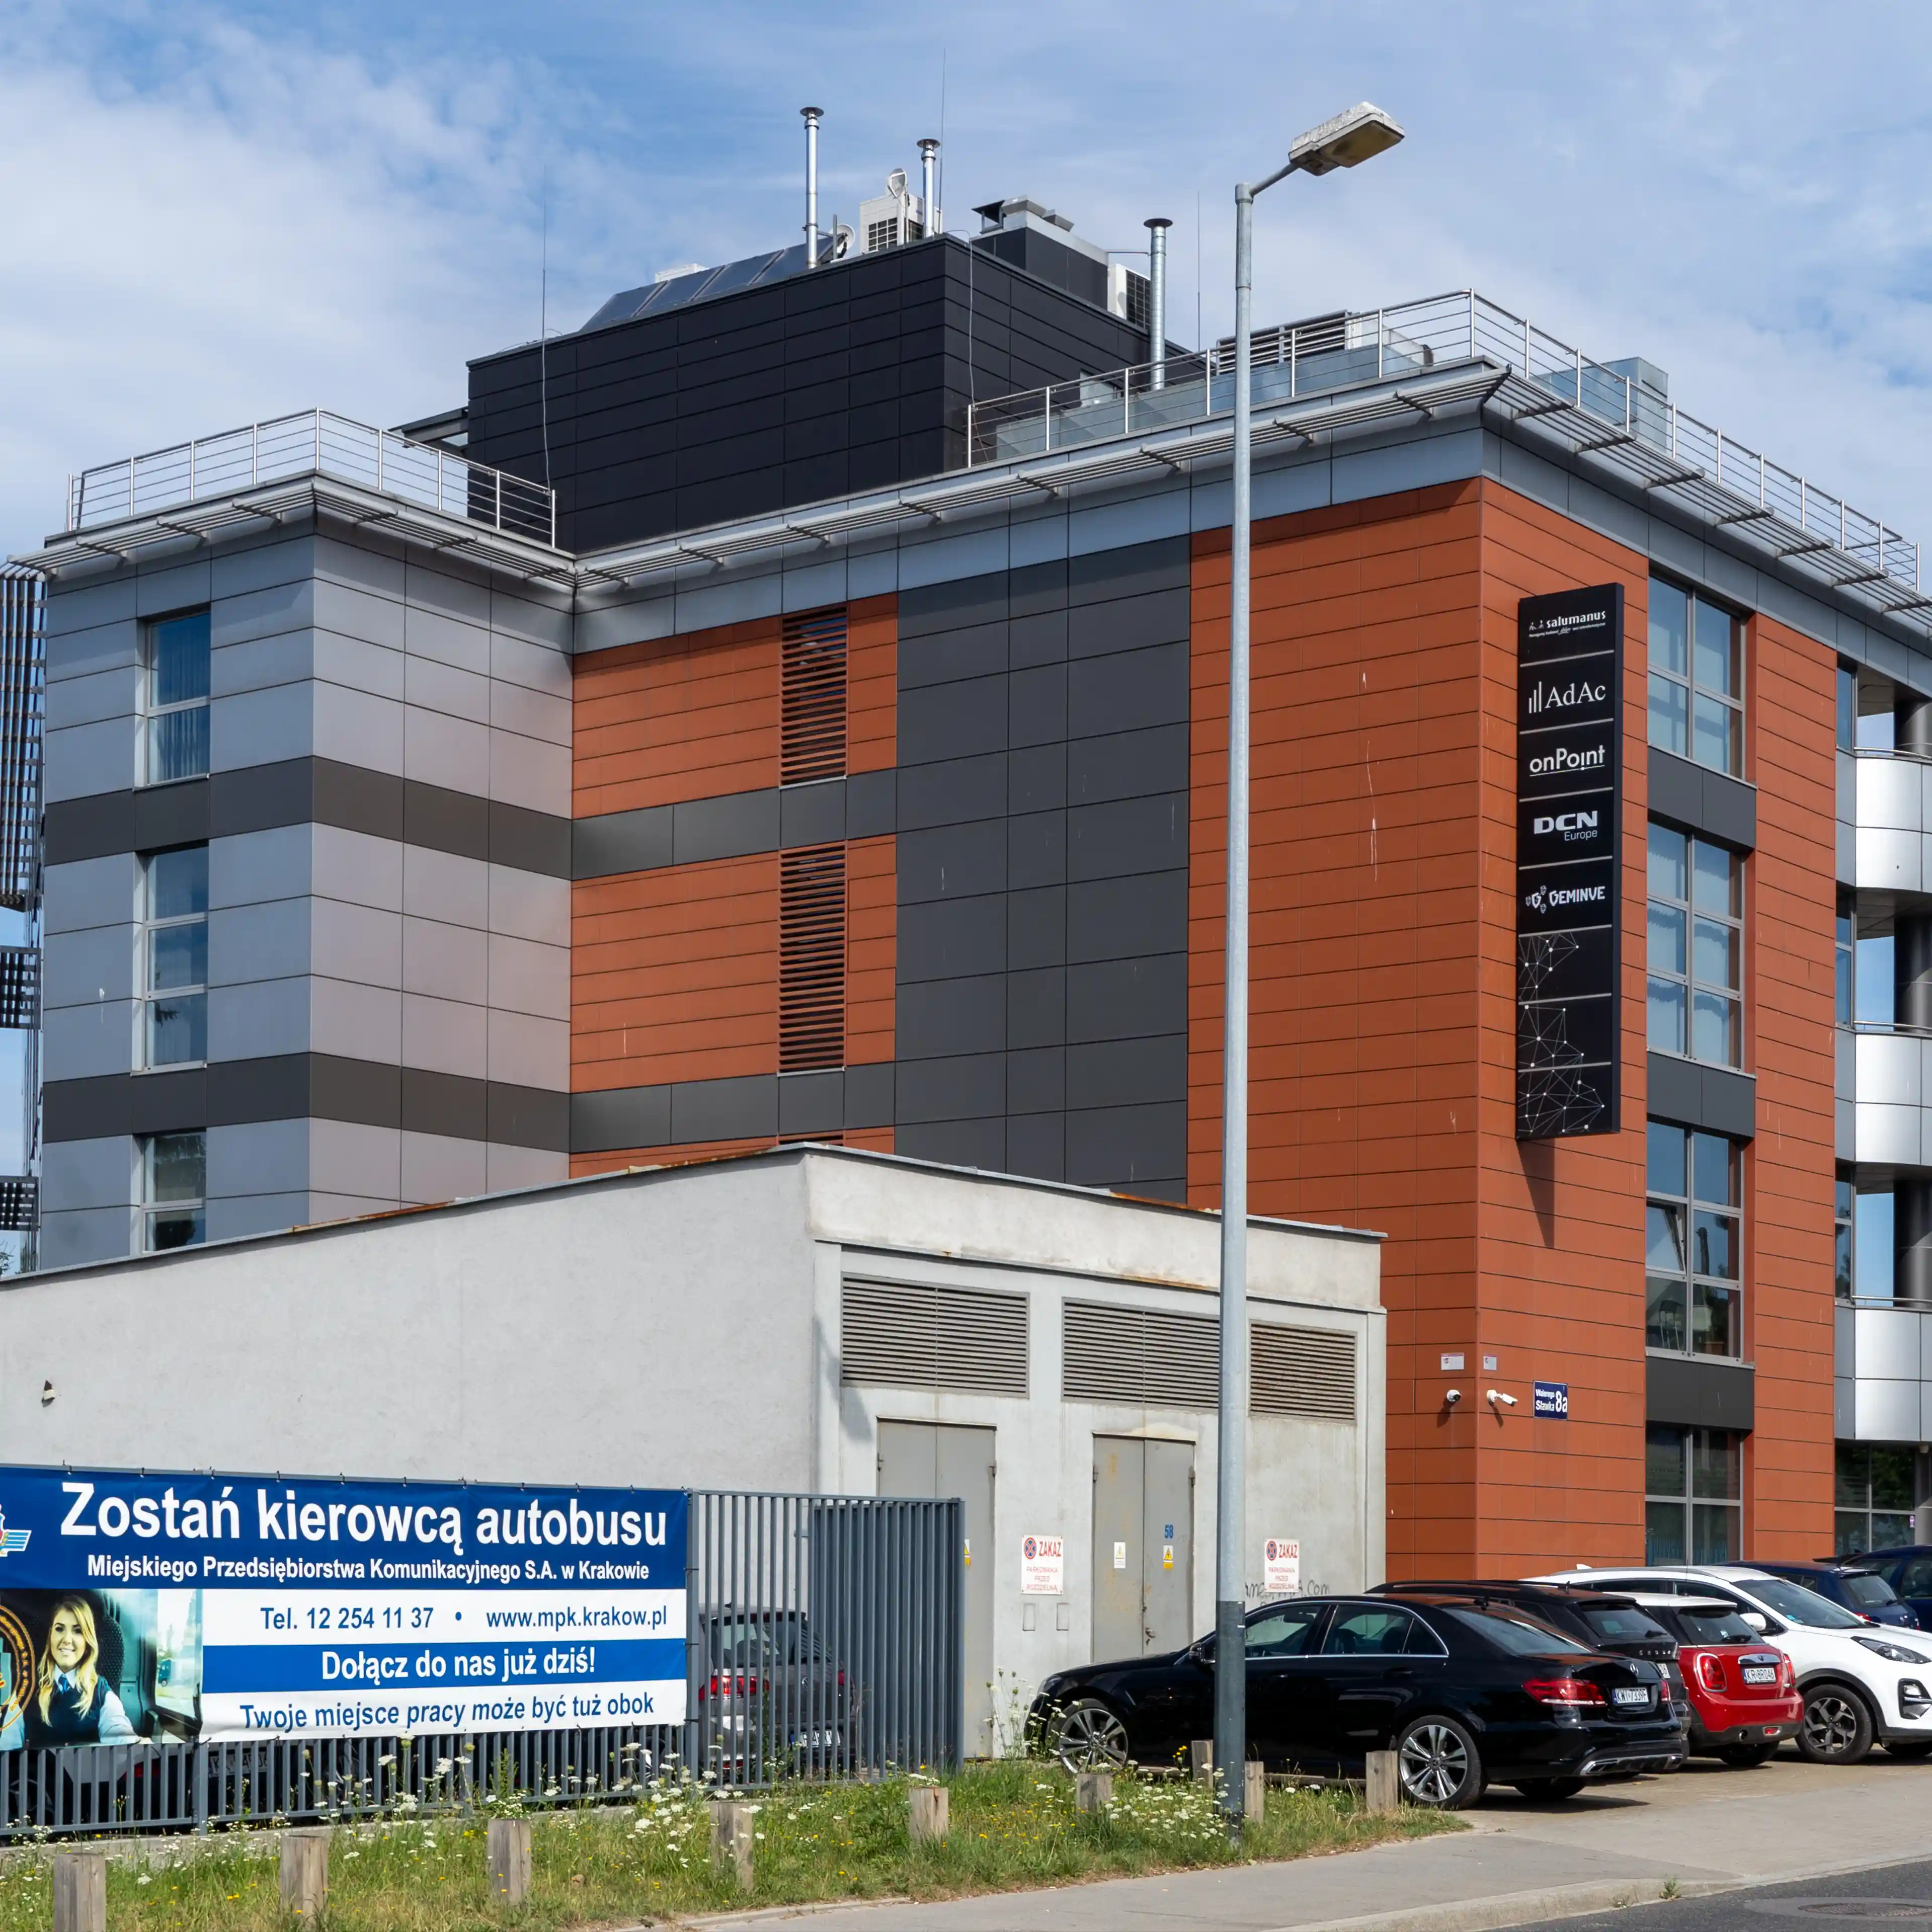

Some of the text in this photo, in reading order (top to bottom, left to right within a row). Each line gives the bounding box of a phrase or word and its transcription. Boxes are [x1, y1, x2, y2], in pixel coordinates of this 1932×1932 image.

[1546, 611, 1606, 628] salumanus
[1545, 682, 1606, 708] AdAc
[1534, 811, 1598, 834] DCN
[1564, 829, 1597, 841] Europe
[1549, 886, 1605, 906] GEMINVE
[1555, 1390, 1568, 1413] 8a
[61, 1482, 666, 1556] Zostań kierowcą autobusu
[1164, 1524, 1174, 1539] 58
[1038, 1541, 1061, 1557] ZAKAZ
[1278, 1544, 1298, 1558] ZAKAZ
[88, 1555, 649, 1584] Miejskiego Przedsiębiorstwa Komunikacyjnego S.A. w Krakowie
[260, 1605, 667, 1632] Tel. 12 254 11 37 www.mpk.krakow.pl
[322, 1647, 595, 1685] Dołącz do nas już dziś!
[240, 1692, 654, 1733] Twoje miejsce pracy może być tuż obok
